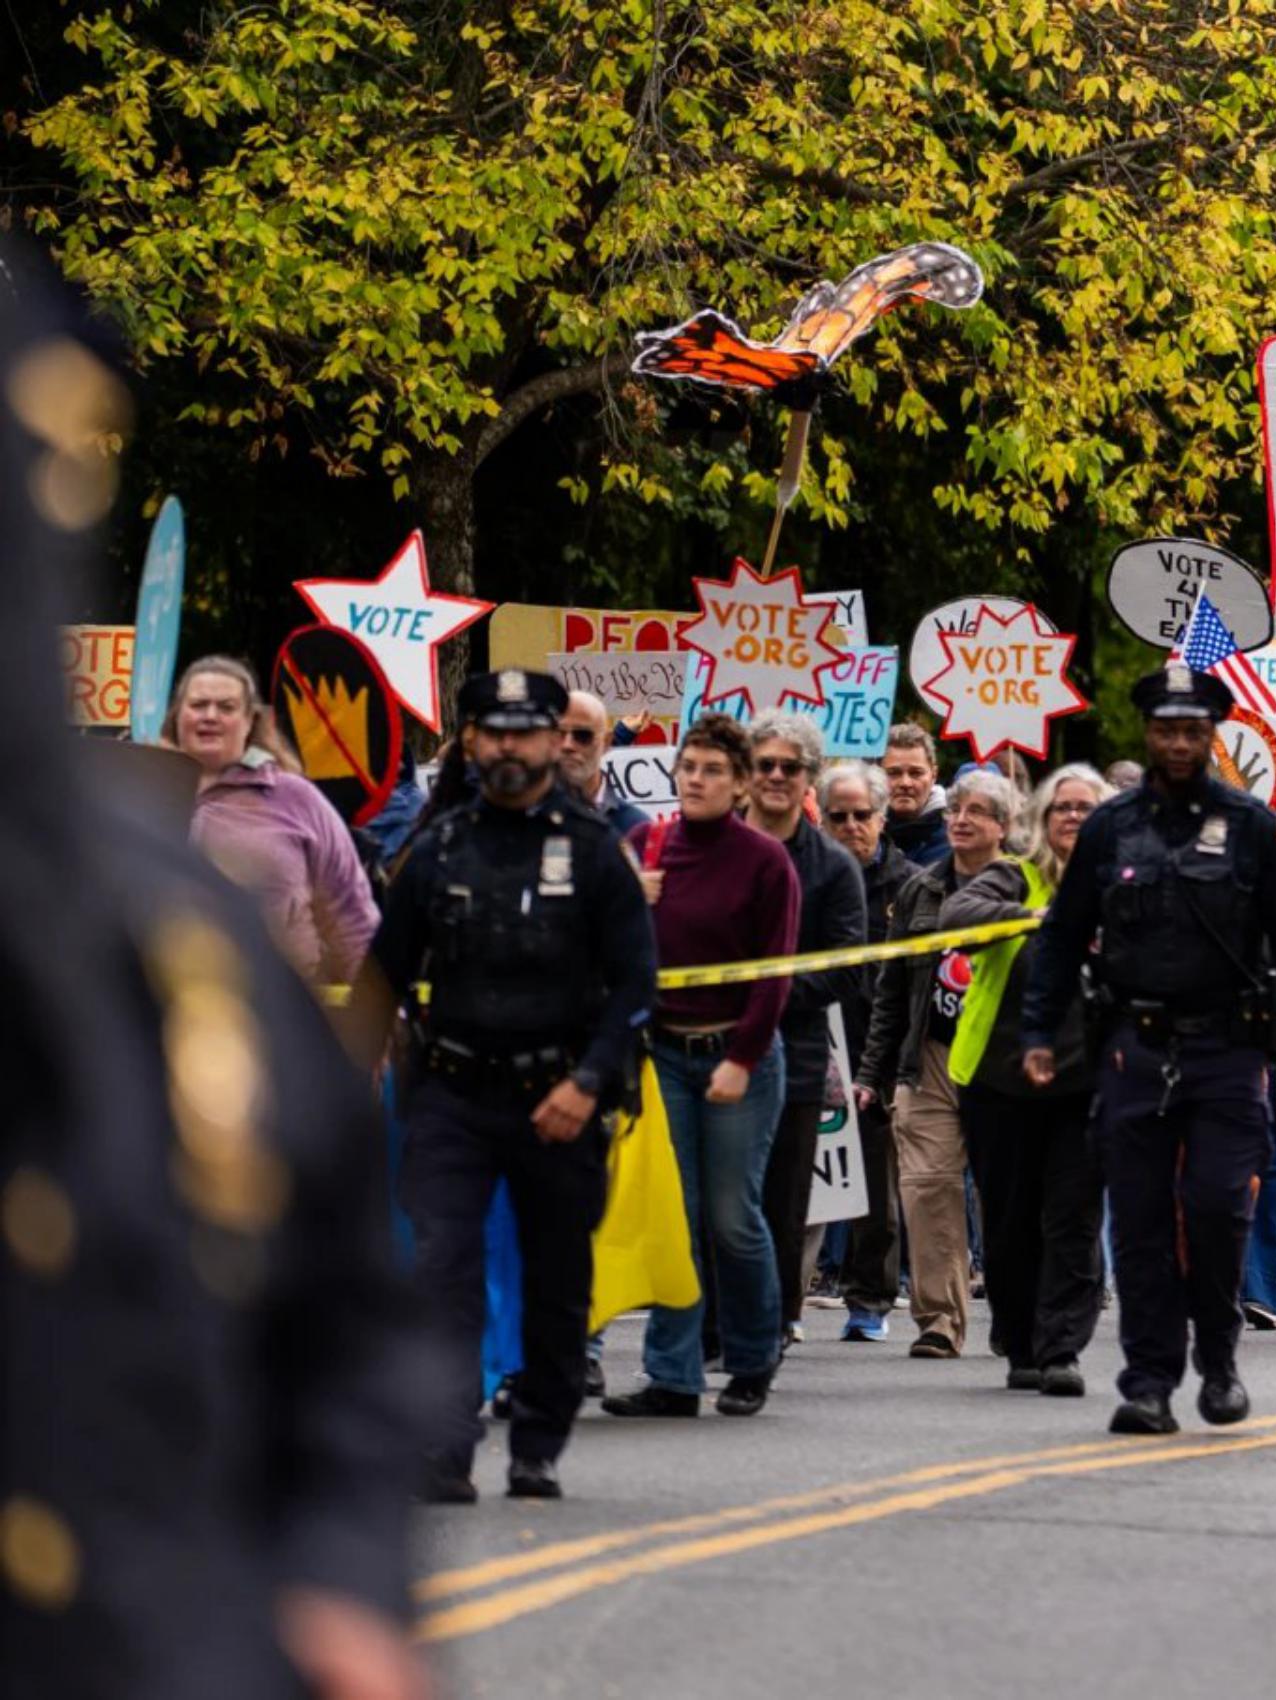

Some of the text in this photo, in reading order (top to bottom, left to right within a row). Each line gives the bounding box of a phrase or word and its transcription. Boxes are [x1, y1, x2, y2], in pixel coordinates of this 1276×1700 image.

[1157, 550, 1223, 580] VOTE
[349, 602, 434, 641] VOTE
[709, 600, 809, 639] VOTE
[723, 634, 810, 669] .ORG
[959, 644, 1053, 675] VOTE
